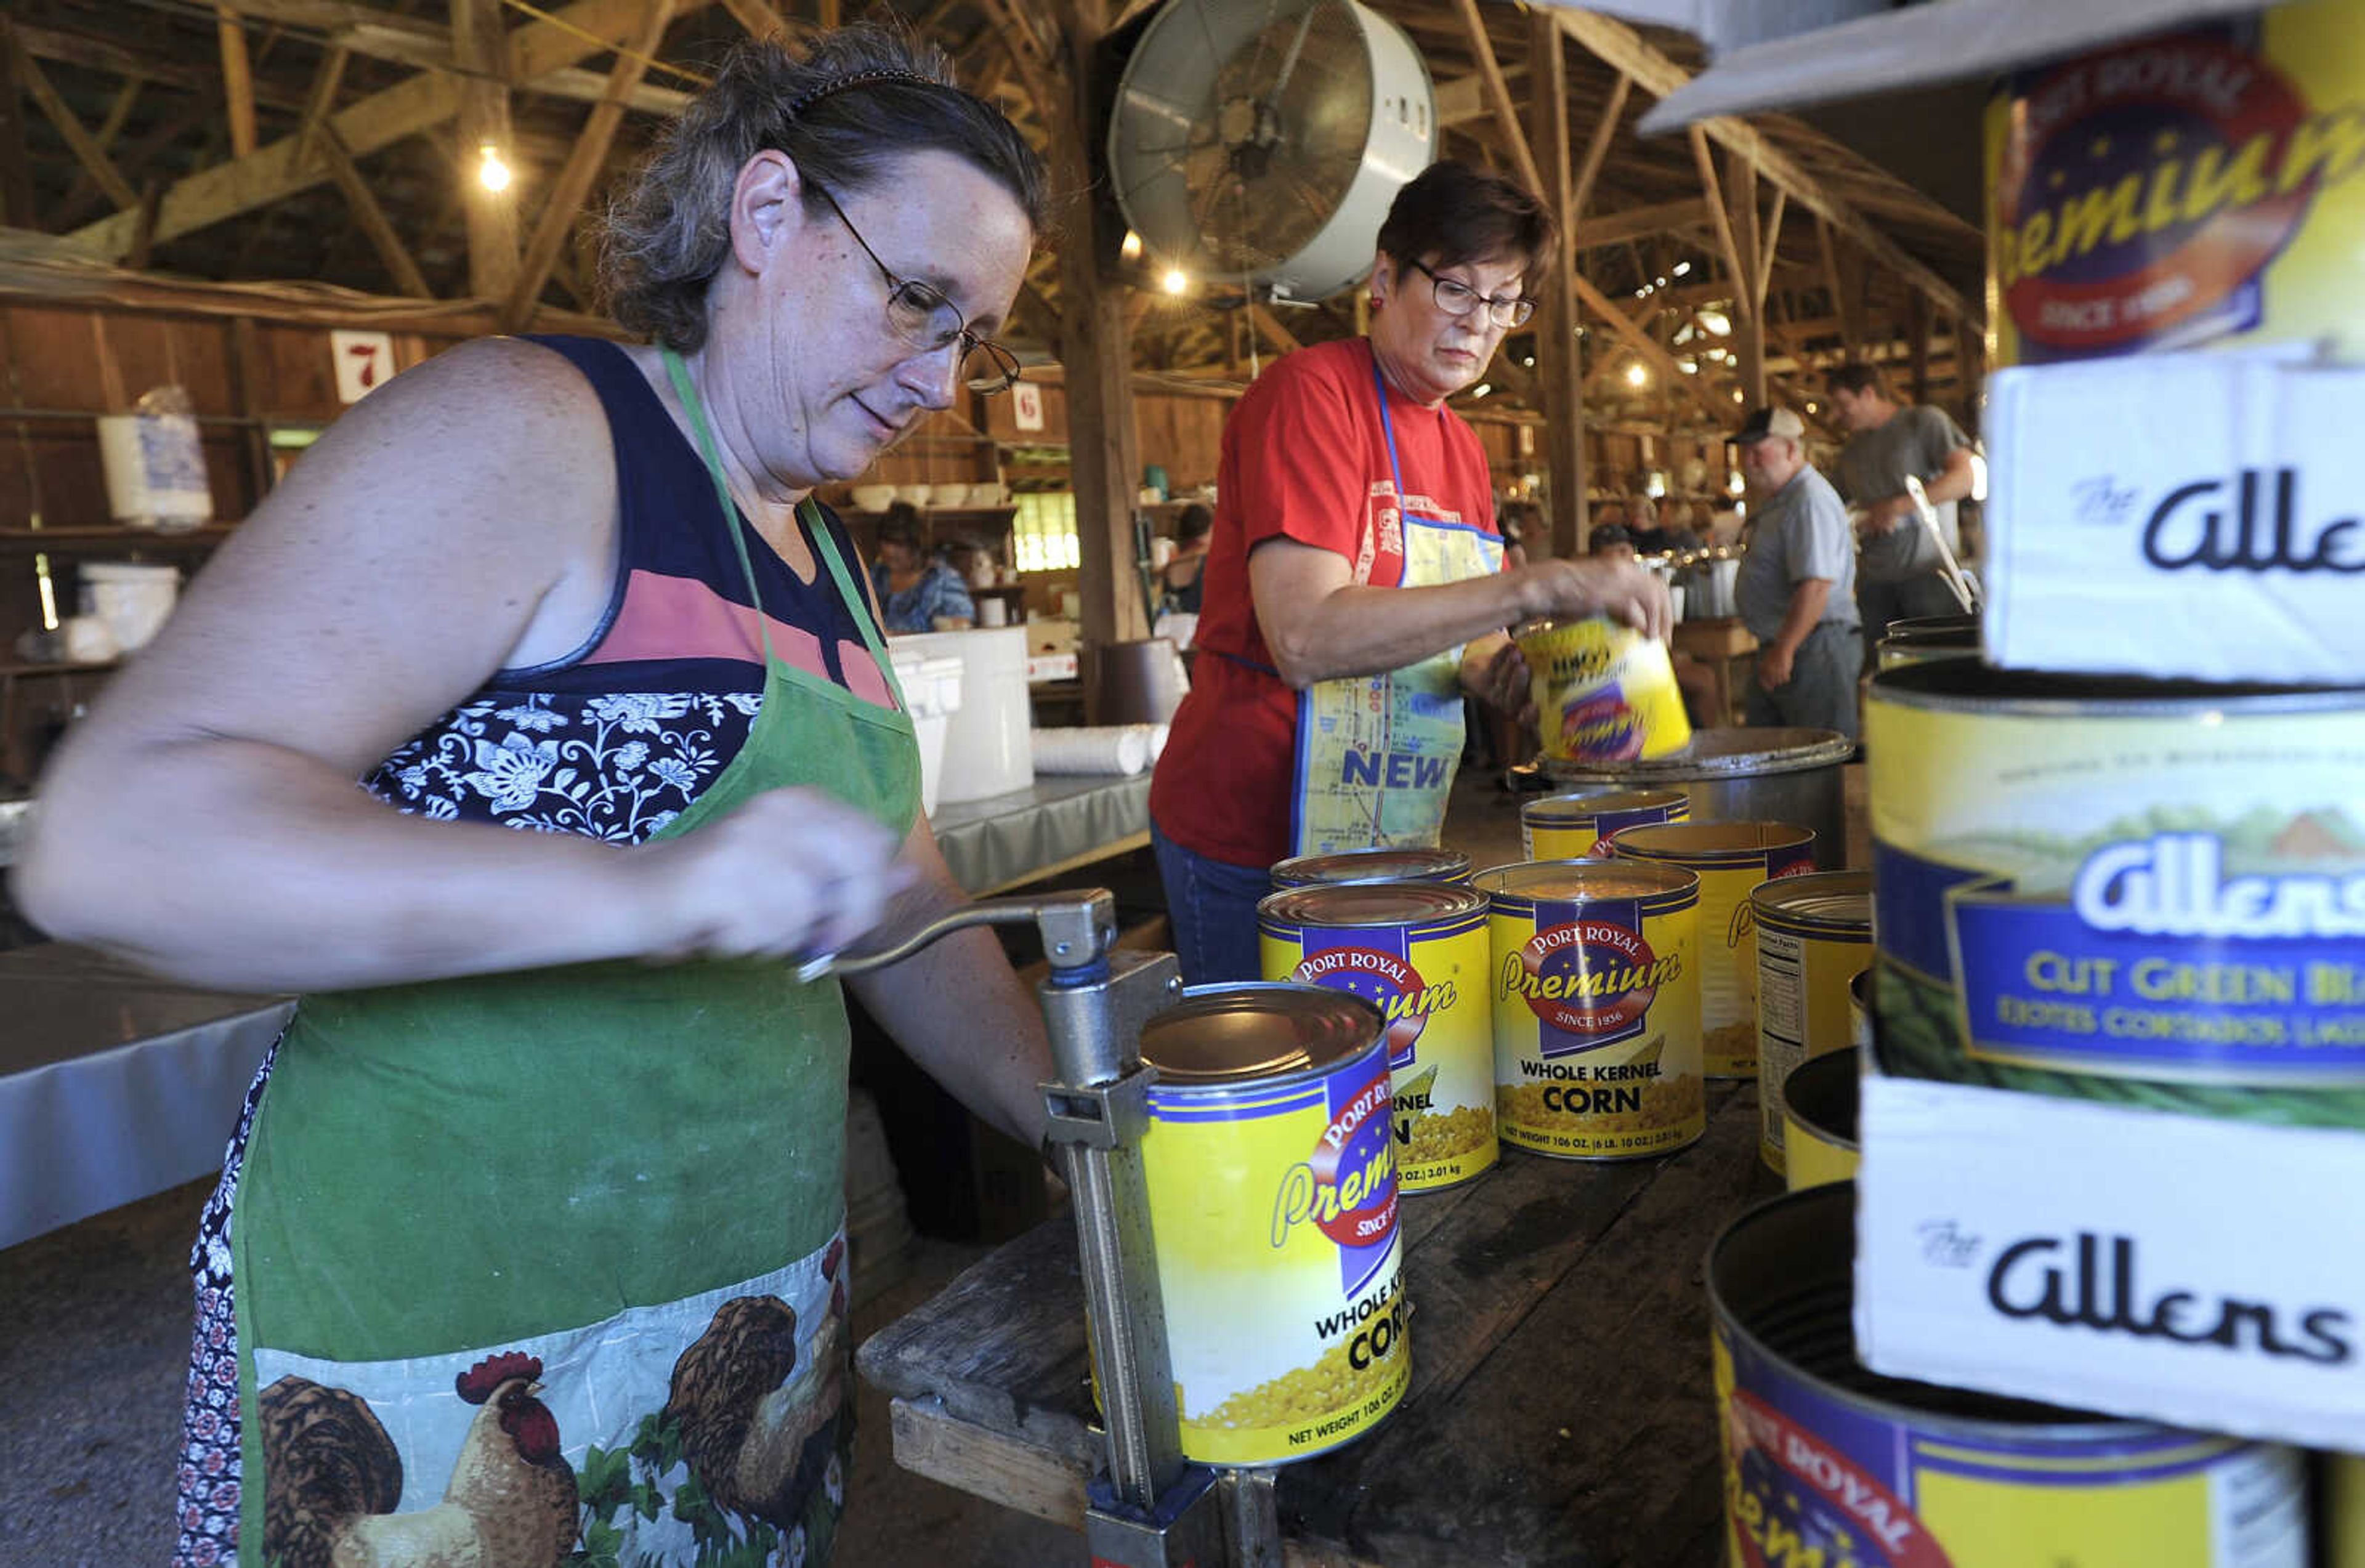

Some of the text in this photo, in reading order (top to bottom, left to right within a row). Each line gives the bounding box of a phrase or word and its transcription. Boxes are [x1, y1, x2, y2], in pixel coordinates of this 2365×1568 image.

[347, 344, 377, 388] 7
[1020, 392, 1036, 419] 6
[1342, 749, 1449, 790] NEW
[1532, 926, 1641, 956] PORT ROYAL
[1300, 953, 1407, 984] PORT ROYAL
[1500, 950, 1683, 1002] Premium
[2024, 950, 2119, 996] CUT
[1555, 1011, 1595, 1029] SINCE
[1521, 1059, 1662, 1081] WHOLE KERNEL
[1543, 1086, 1641, 1114] CORN
[1324, 1089, 1373, 1150] PORT
[1356, 1210, 1387, 1237] SINCE
[1315, 1285, 1387, 1340] WHOLE
[1288, 1429, 1312, 1446] NET
[1316, 1408, 1361, 1439] WEIGHT
[1786, 1432, 1912, 1556] ROYAL
